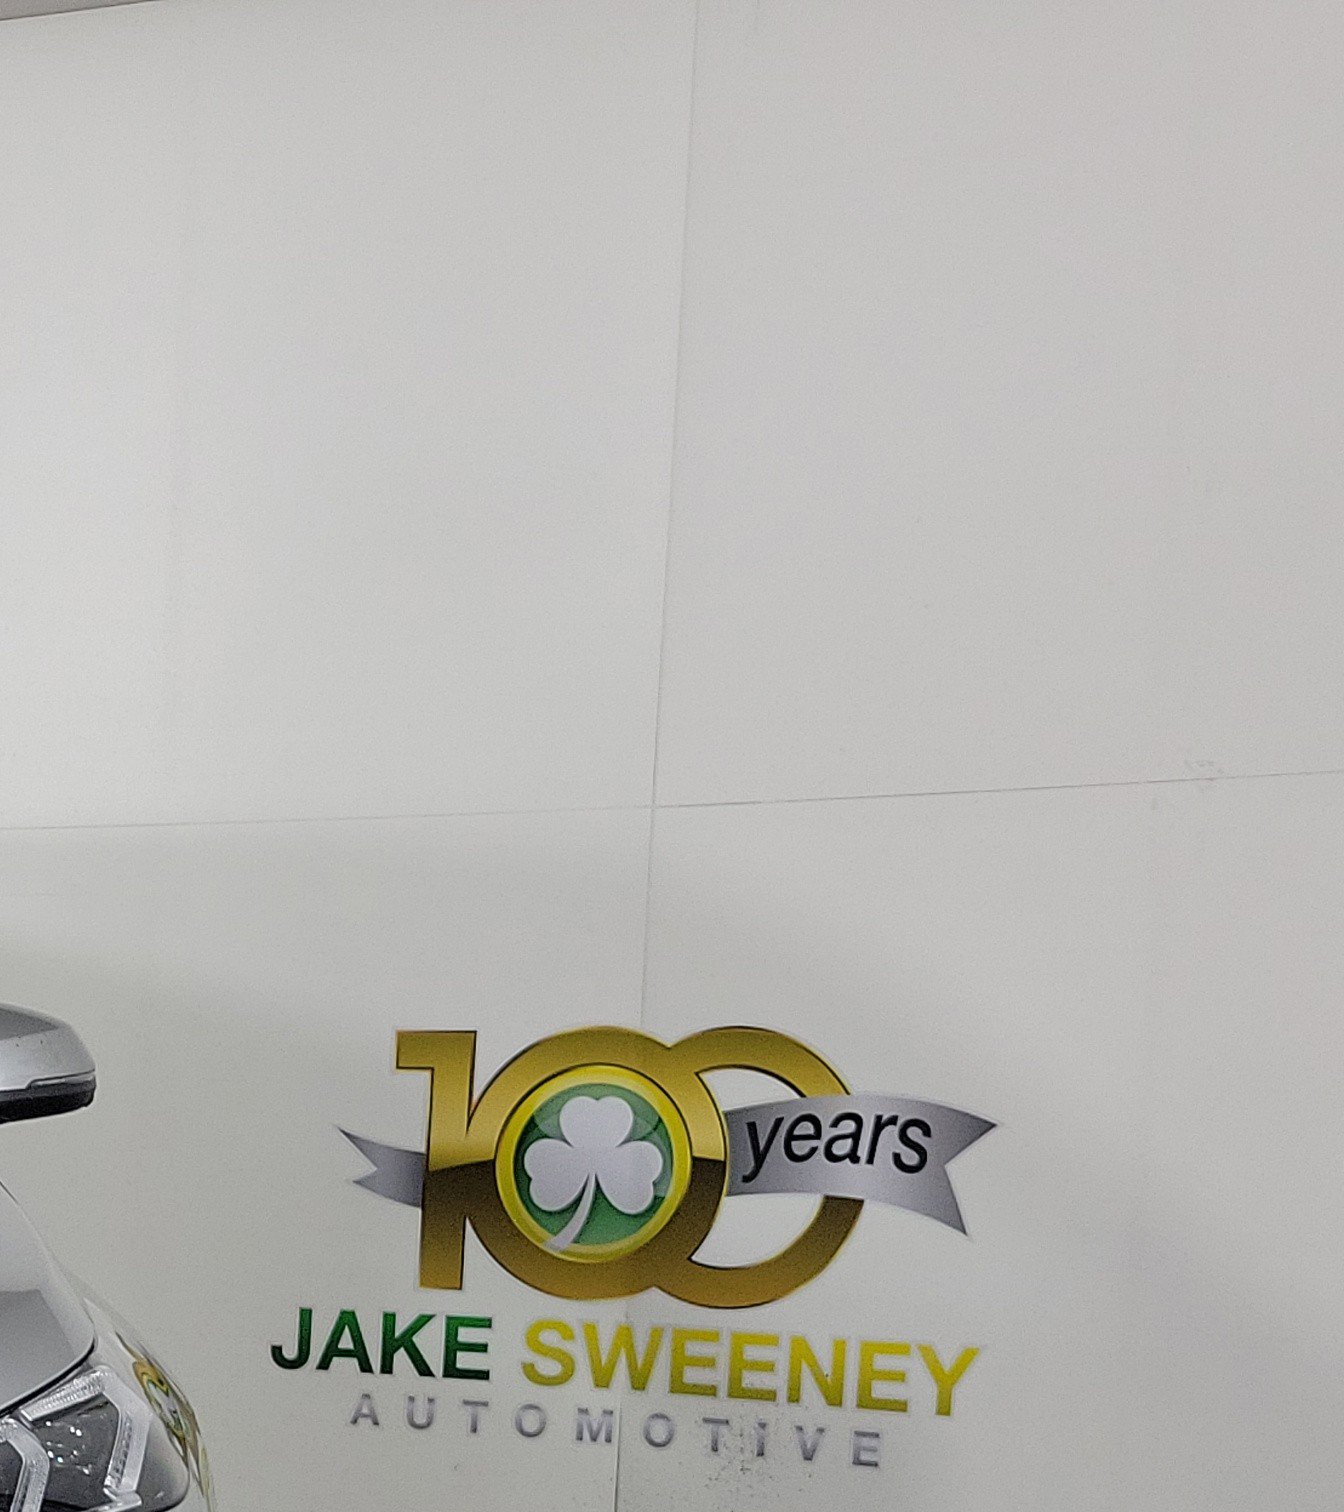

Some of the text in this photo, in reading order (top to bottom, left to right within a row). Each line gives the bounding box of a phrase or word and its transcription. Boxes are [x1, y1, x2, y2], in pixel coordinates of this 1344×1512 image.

[742, 1110, 932, 1184] years
[270, 1307, 979, 1416] JAKE SWEENEY
[350, 1392, 880, 1468] AUTOMOTIVE
